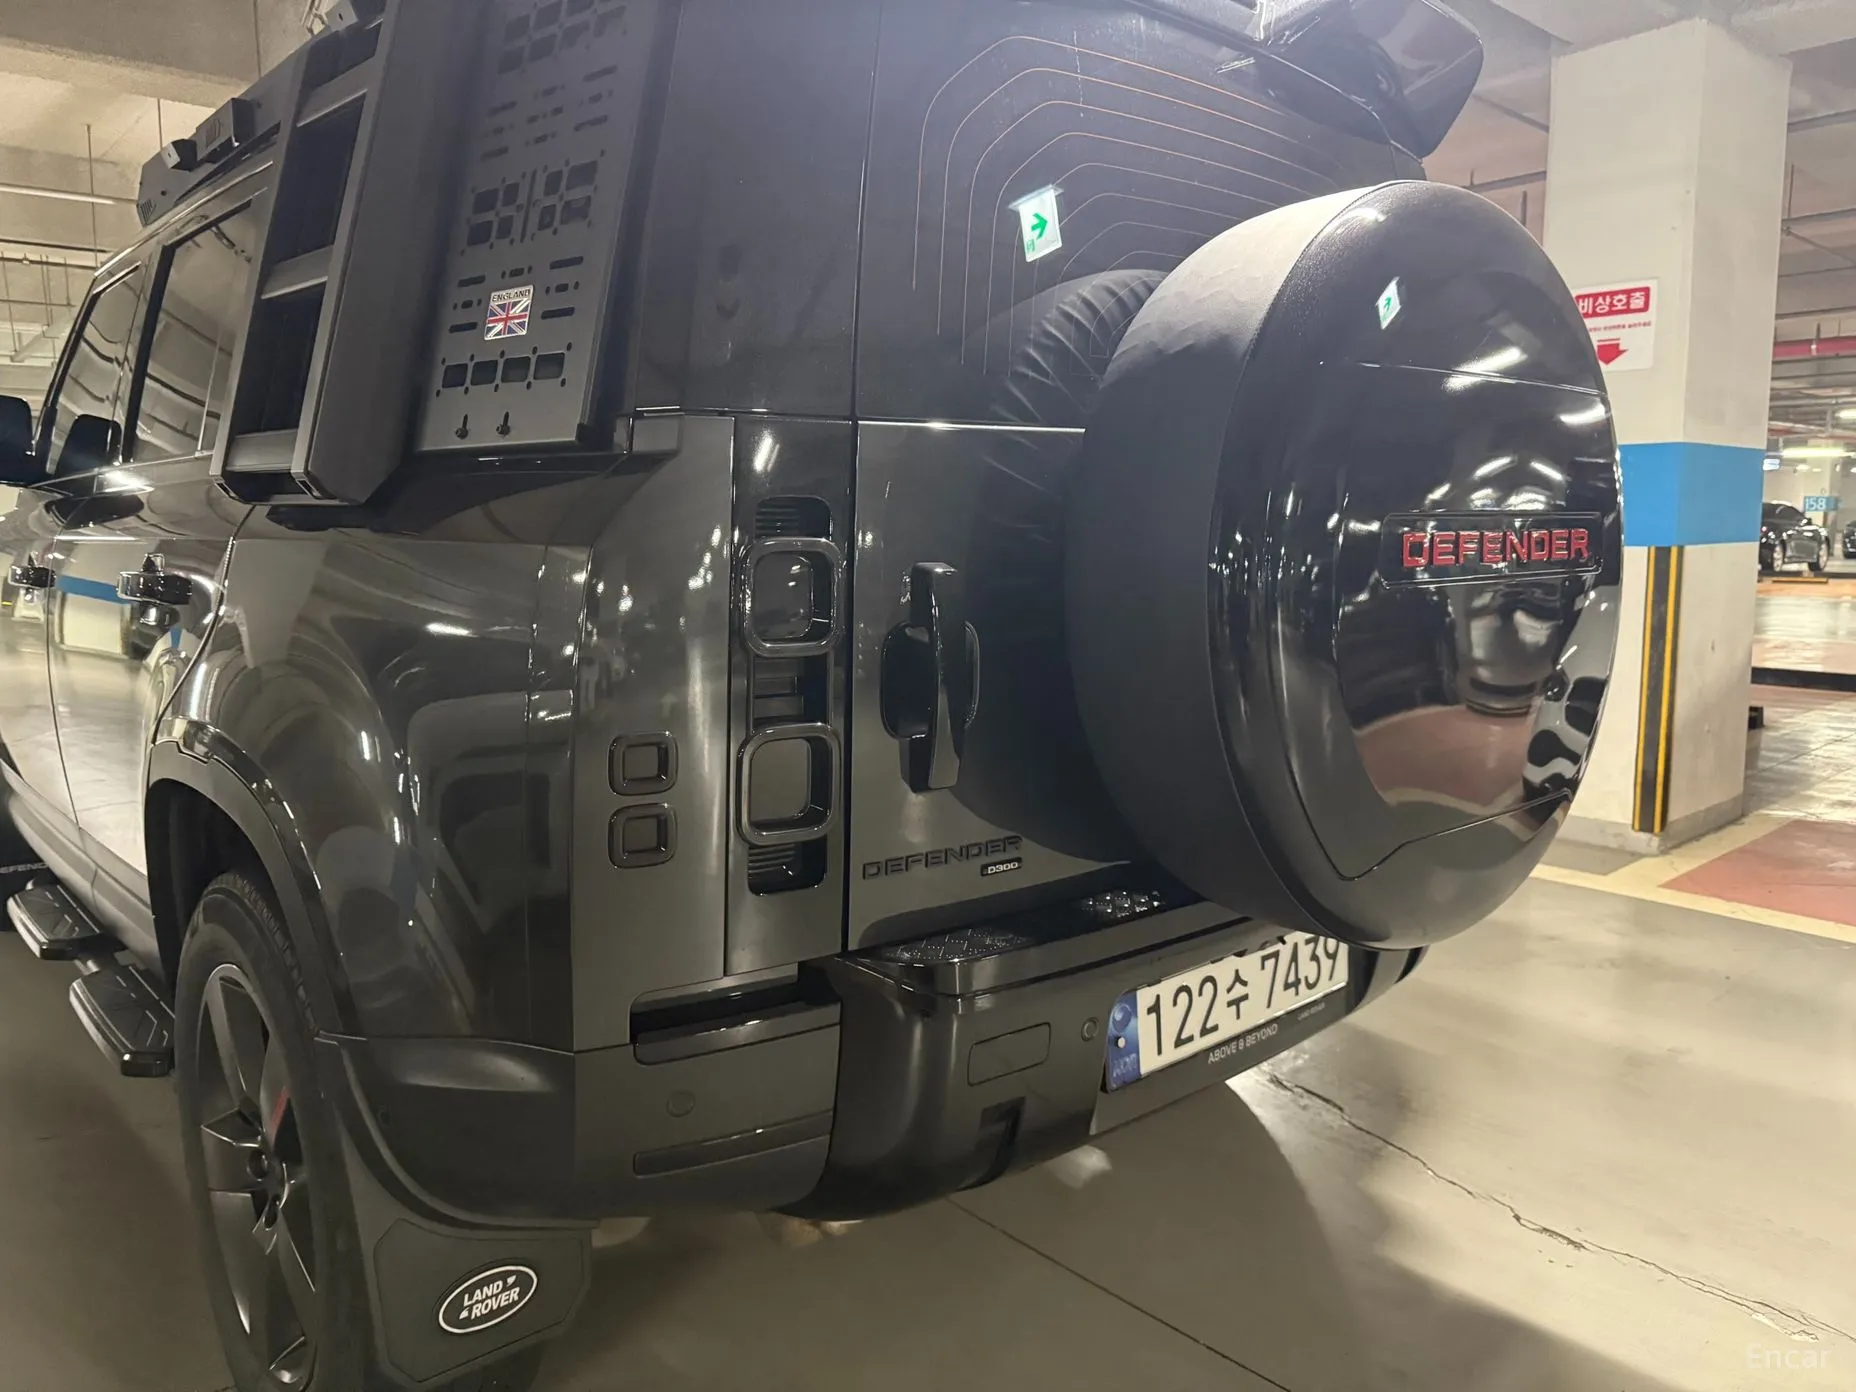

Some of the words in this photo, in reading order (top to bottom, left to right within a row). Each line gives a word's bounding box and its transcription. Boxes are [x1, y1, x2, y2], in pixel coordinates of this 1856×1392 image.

[492, 289, 531, 302] ENGLAND
[1578, 291, 1646, 315] 비상호출
[1402, 528, 1590, 568] DEFENDER
[862, 835, 1023, 880] DEFENDER
[987, 861, 1019, 874] D300
[1146, 968, 1250, 1057] 122수
[1260, 936, 1340, 1010] 7439
[1207, 1041, 1237, 1065] ABOVE
[1245, 1023, 1278, 1048] BEYOND
[463, 1280, 503, 1307] LAND
[471, 1287, 520, 1319] ROVER
